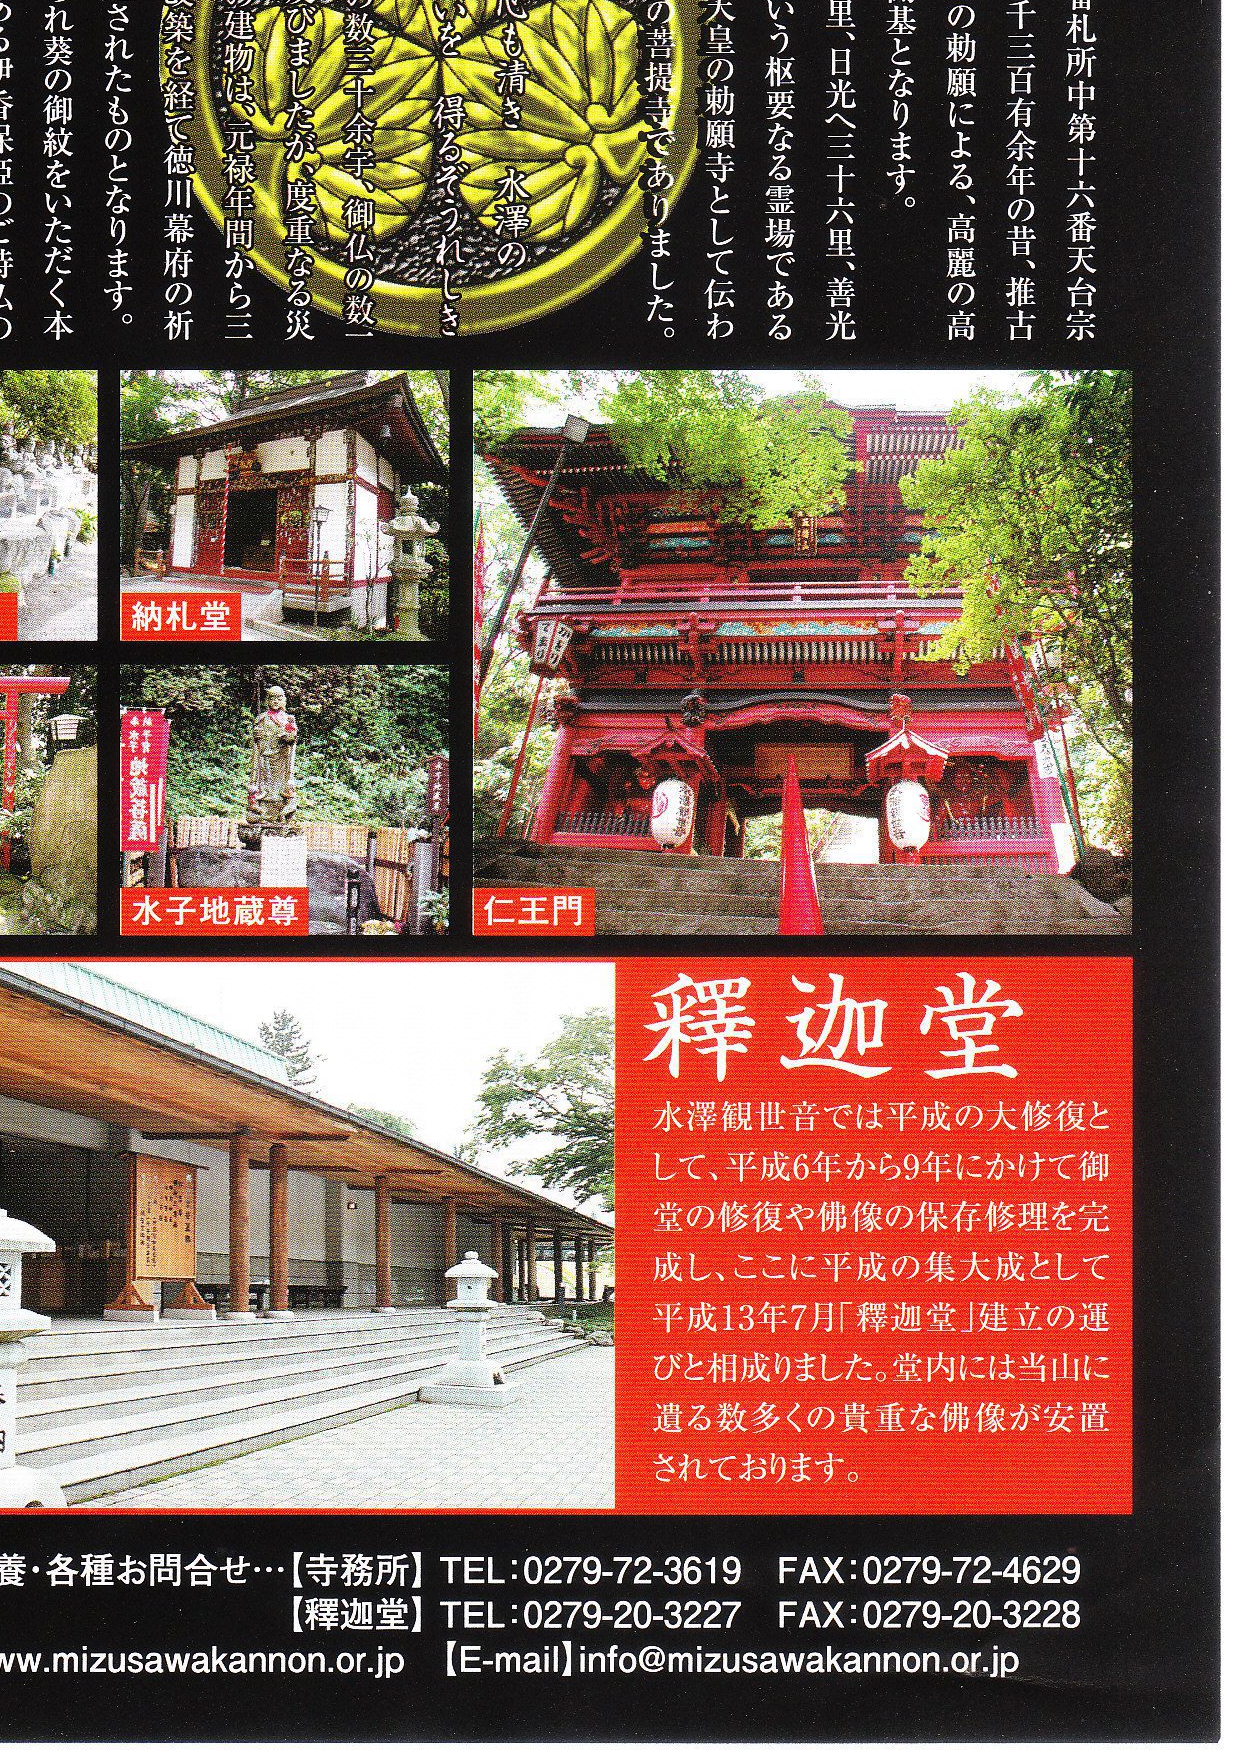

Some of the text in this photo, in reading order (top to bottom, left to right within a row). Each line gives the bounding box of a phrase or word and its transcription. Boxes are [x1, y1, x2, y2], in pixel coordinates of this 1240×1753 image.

[434, 96, 468, 336] 得るぞうれしき
[497, 169, 529, 266] 水澤の
[132, 601, 230, 631] 納札堂
[132, 895, 298, 926] 水子地蔵尊
[484, 896, 582, 925] 仁王門
[642, 972, 1023, 1082] 釋迦堂
[652, 1100, 1109, 1132] 水澤観世音では平成の大修復と
[654, 1151, 1108, 1182] して、平成6年から9年にかけて御
[654, 1201, 1109, 1232] 堂の修復や佛像の保存修理を完
[654, 1251, 1109, 1282] 成し、ここに平成の集大成として
[653, 1301, 1109, 1333] 平成13年7月「釋迦堂」建立の運
[654, 1352, 1109, 1383] びと相成りました。堂内には当山に
[653, 1402, 1109, 1433] 遺る数多くの貴重な佛像が安置
[654, 1453, 858, 1483] されております。
[294, 1596, 421, 1632] 【釋迦堂】
